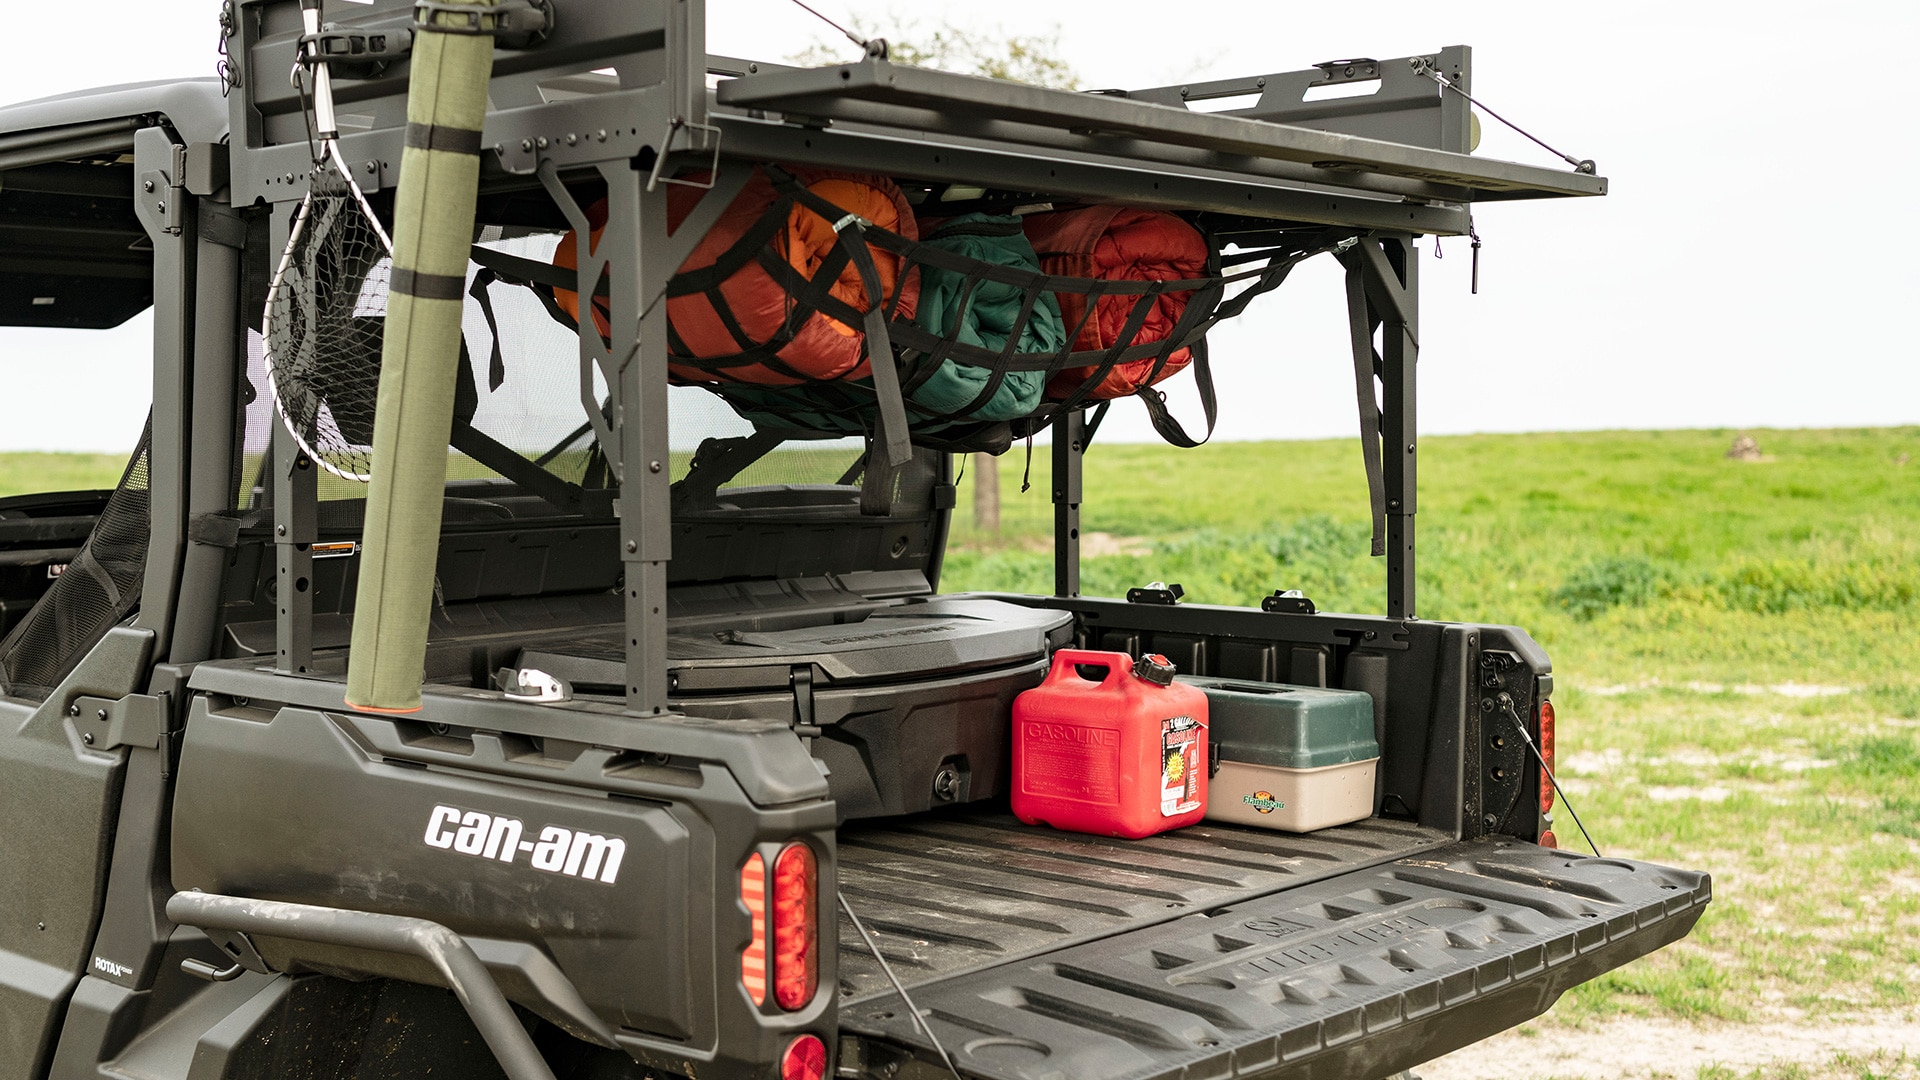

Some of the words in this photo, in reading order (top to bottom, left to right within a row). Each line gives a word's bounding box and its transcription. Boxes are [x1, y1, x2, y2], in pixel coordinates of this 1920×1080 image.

[1028, 722, 1116, 746] GASOLINE
[1242, 795, 1285, 809] Flambeau
[423, 804, 626, 885] can-am
[95, 956, 122, 977] ROTAX
